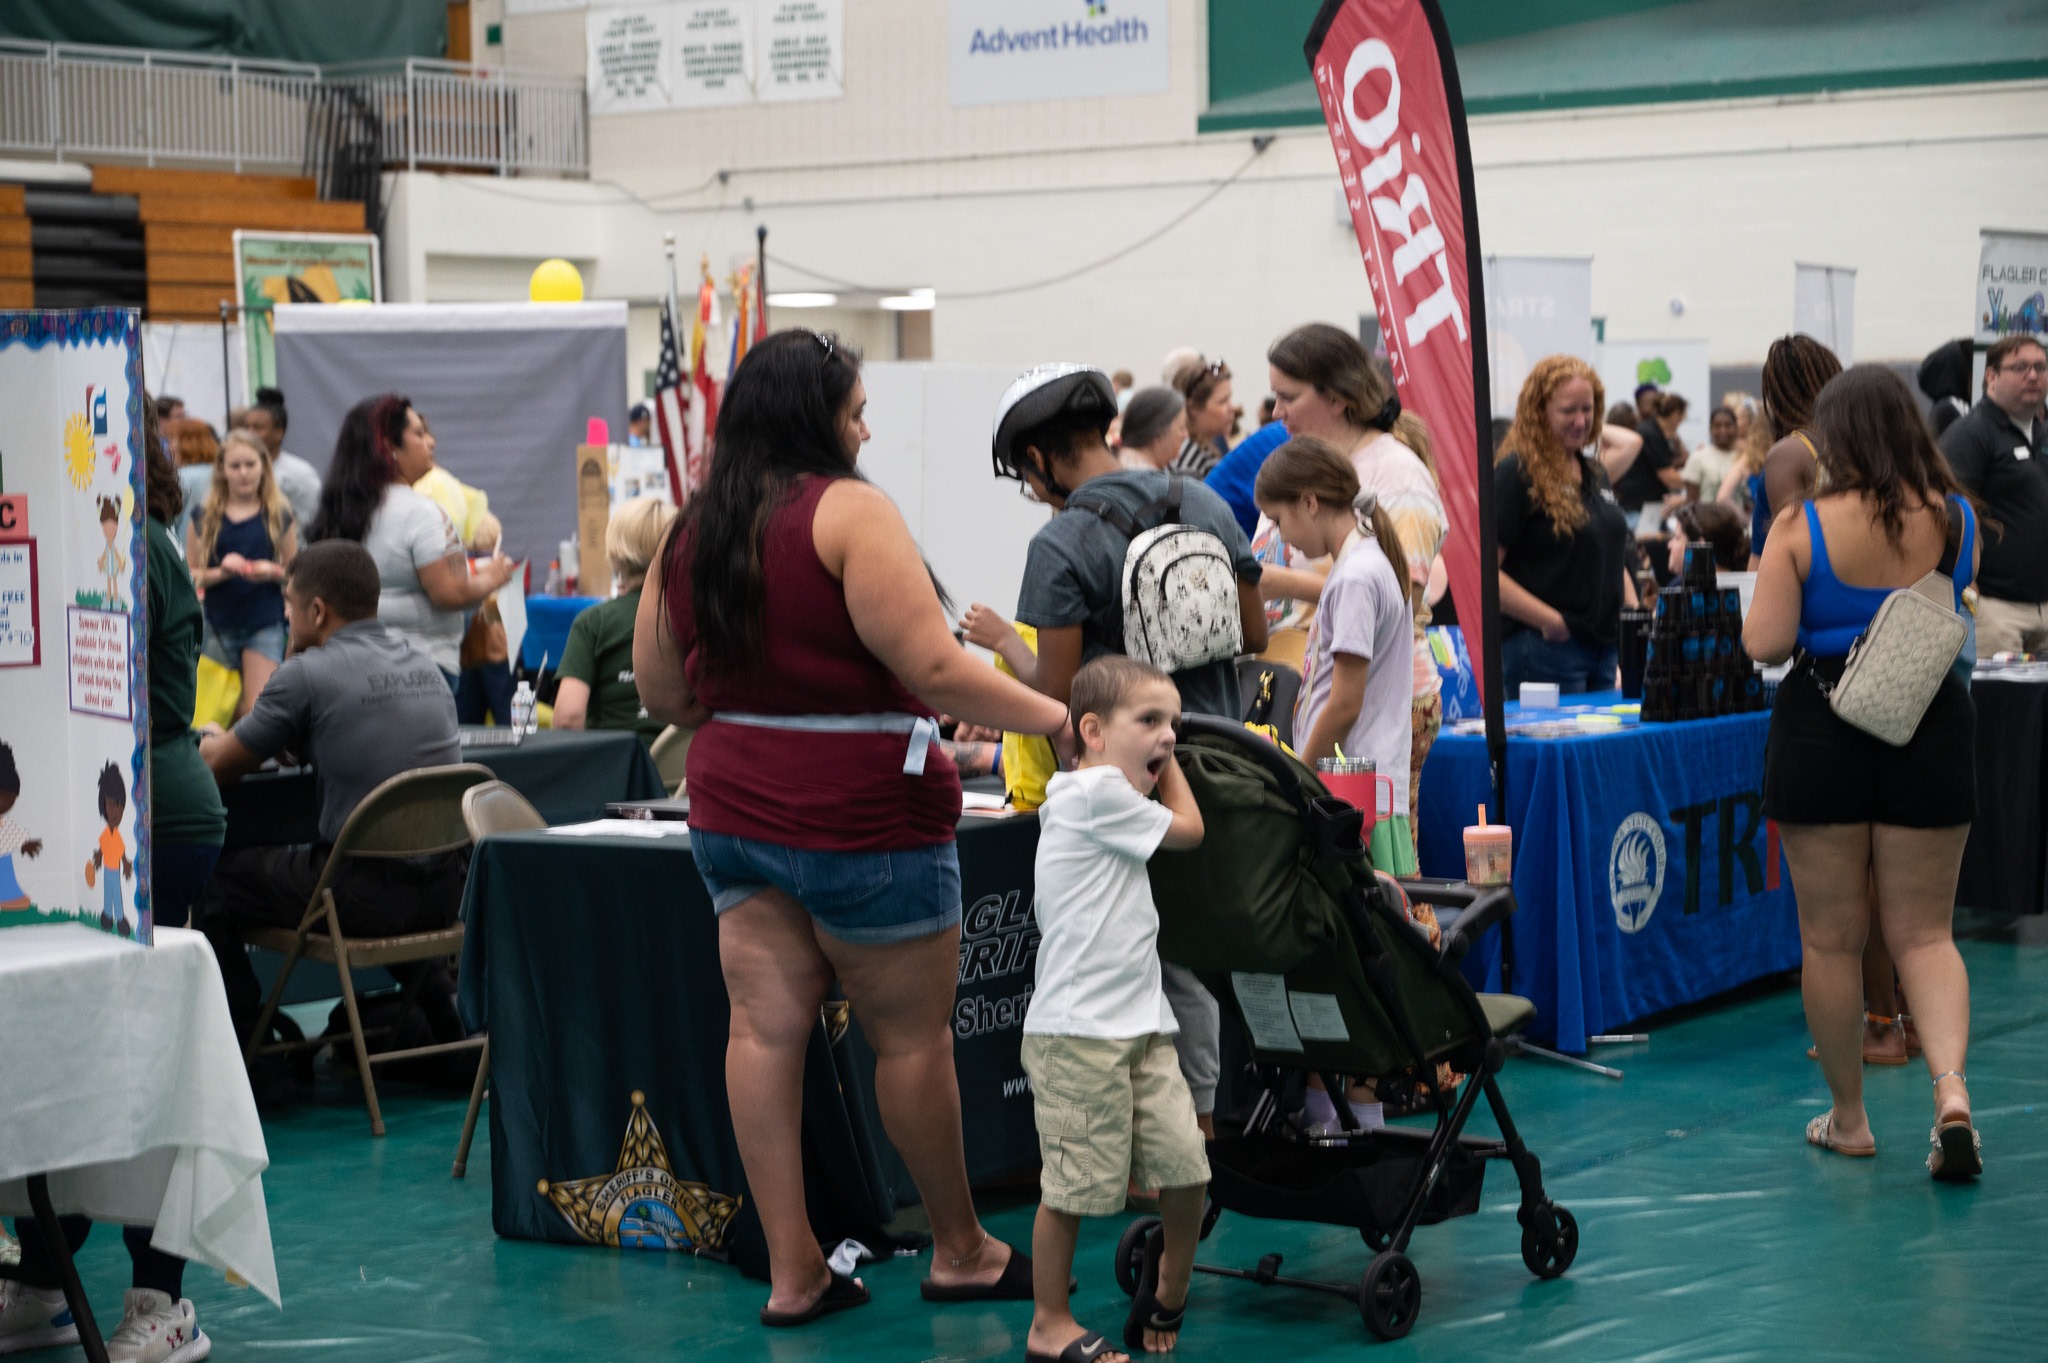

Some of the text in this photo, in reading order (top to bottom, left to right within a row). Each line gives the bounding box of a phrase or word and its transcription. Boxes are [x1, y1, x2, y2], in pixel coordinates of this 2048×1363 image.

[1982, 264, 2037, 284] FLAGLER
[2, 590, 26, 604] FREE
[78, 612, 100, 630] Summer
[75, 634, 122, 652] available for those
[72, 652, 126, 672] students who did not
[77, 671, 122, 692] attend during the
[84, 690, 100, 706] school
[964, 889, 1037, 941] GL
[596, 1169, 700, 1217] SHERIFF'S OFFICE
[619, 1185, 678, 1210] FLAGLER
